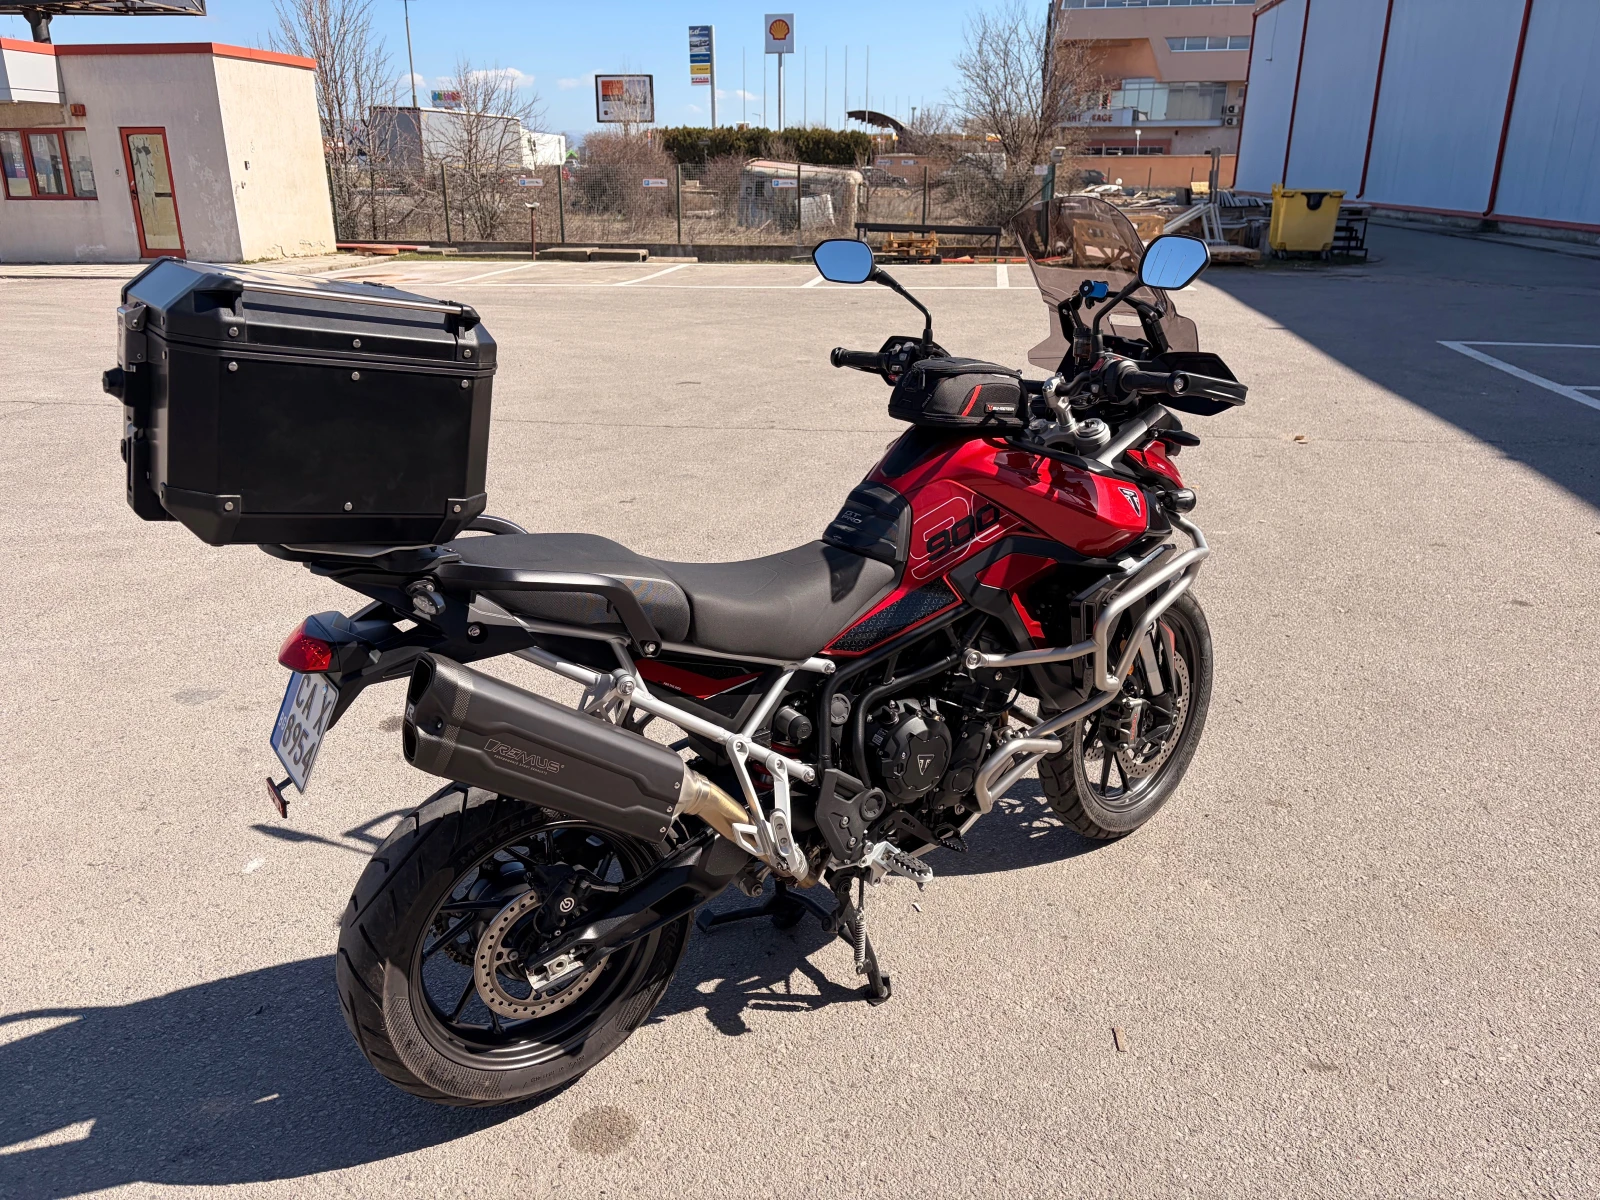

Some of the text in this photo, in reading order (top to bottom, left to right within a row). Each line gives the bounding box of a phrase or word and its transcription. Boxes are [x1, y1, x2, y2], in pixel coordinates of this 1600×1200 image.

[841, 514, 862, 524] PRO
[926, 503, 1000, 561] 900
[282, 713, 317, 778] 8954
[492, 743, 561, 774] REMUS
